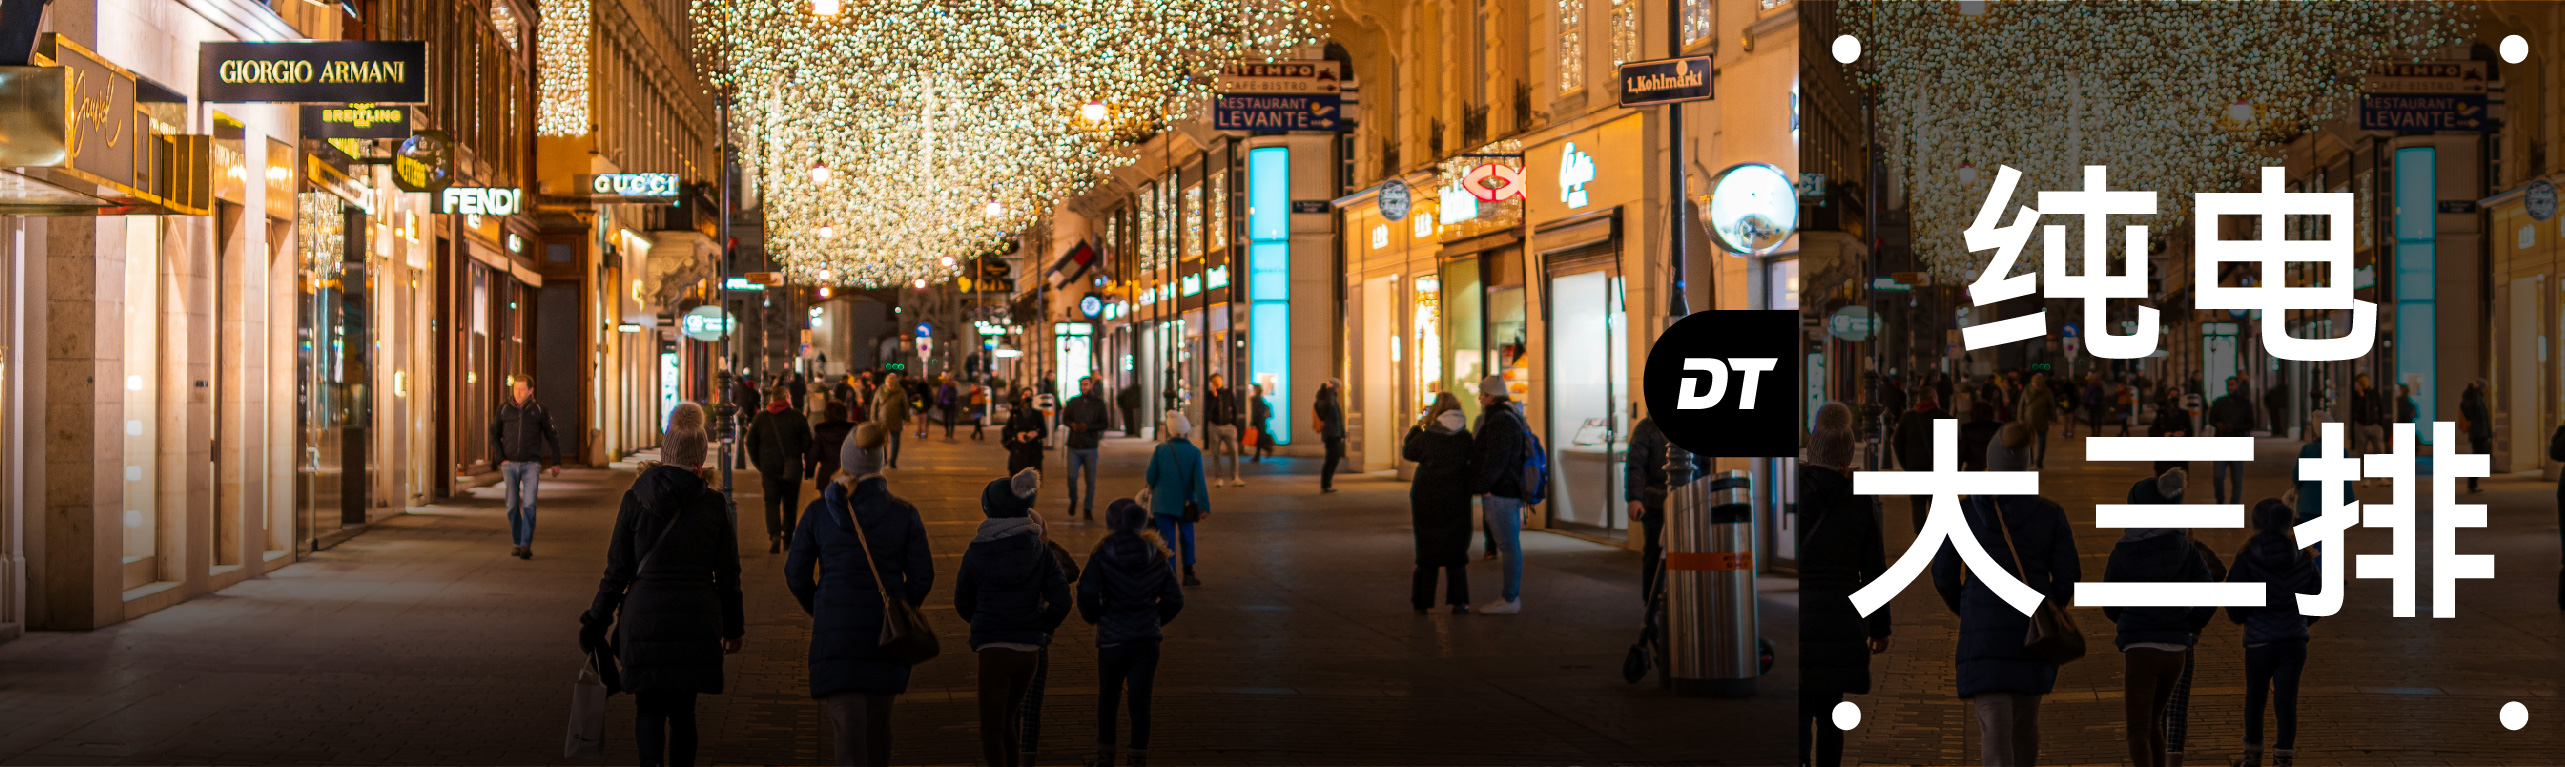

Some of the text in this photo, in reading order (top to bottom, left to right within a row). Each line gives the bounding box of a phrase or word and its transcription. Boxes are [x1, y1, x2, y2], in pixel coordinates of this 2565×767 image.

[219, 60, 405, 83] GIORGIO ARMANI
[1241, 65, 1312, 75] TEMPO
[2388, 65, 2458, 75] TEMPO
[1219, 97, 1308, 109] RESTAURANT
[2366, 97, 2455, 109] RESTAURANT
[322, 110, 402, 123] BREITLING
[1219, 111, 1308, 128] LEVANTE
[2366, 111, 2456, 128] LEVANTE
[594, 175, 675, 194] GUCCI
[443, 187, 520, 215] FENDI
